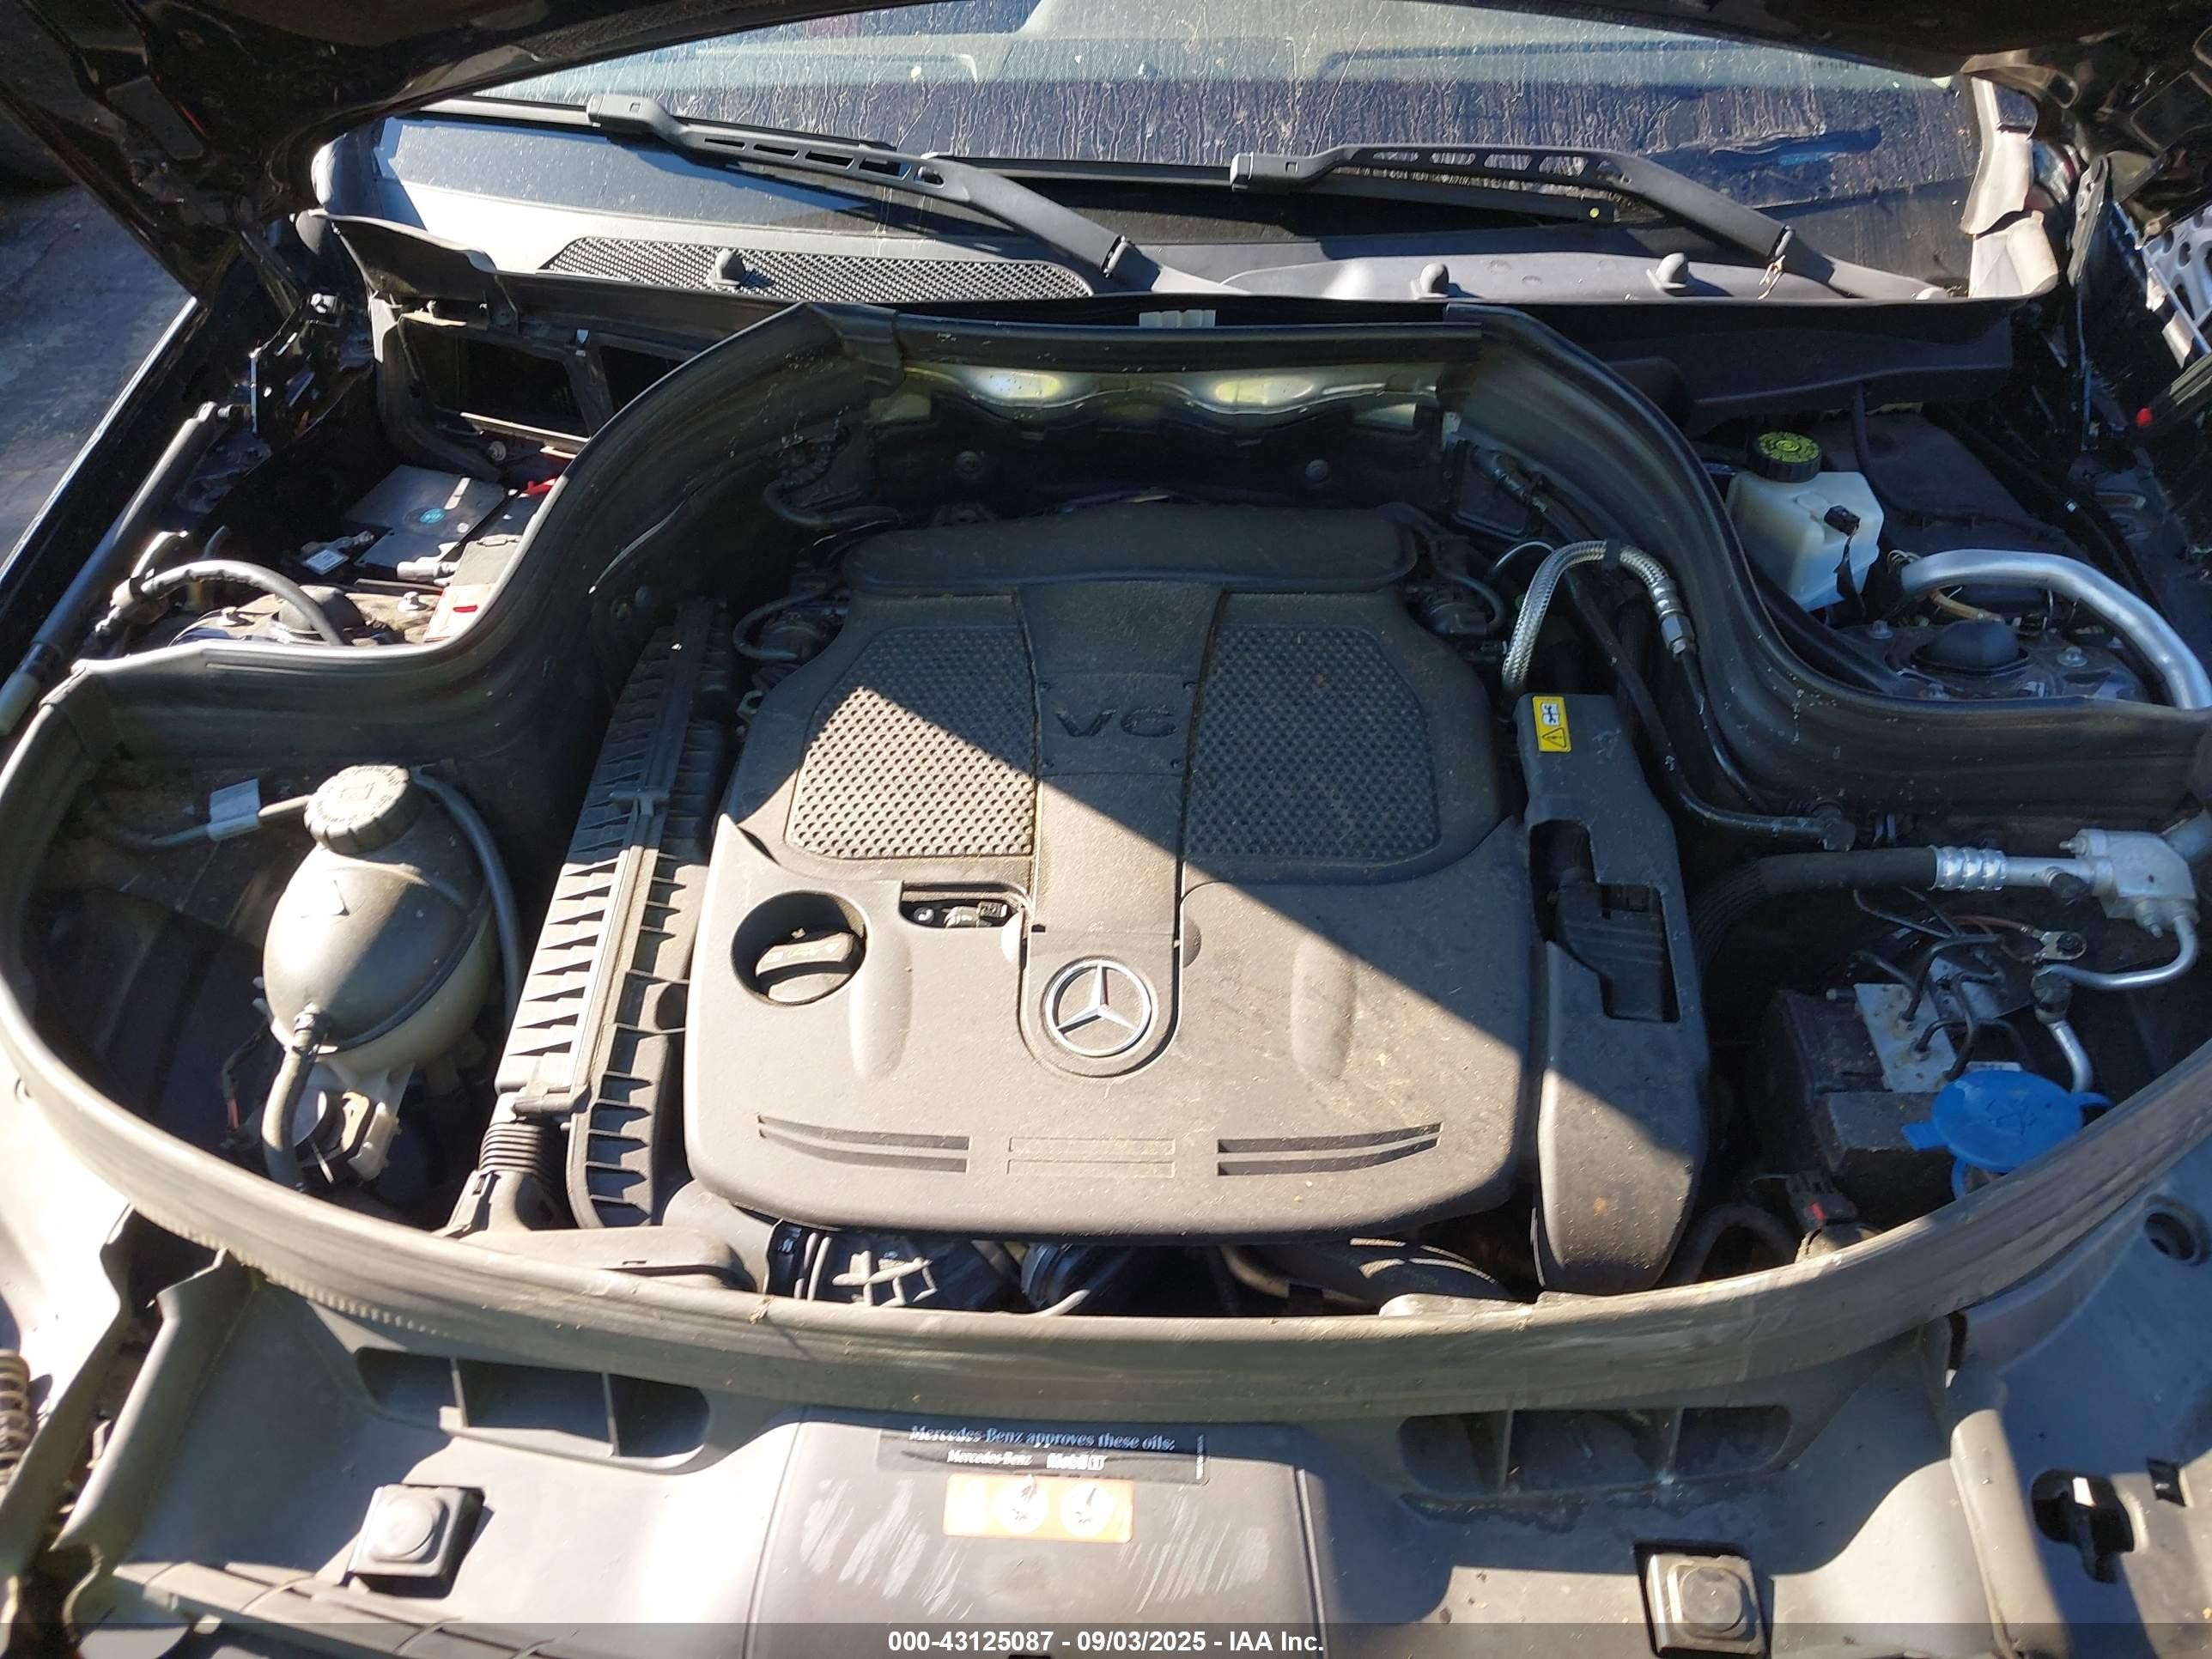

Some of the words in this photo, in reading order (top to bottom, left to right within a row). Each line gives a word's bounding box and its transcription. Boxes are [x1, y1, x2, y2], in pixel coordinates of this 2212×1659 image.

[908, 1425, 1024, 1444] Mercedes-Benz
[1025, 1431, 1095, 1449] approves
[1097, 1432, 1140, 1449] these
